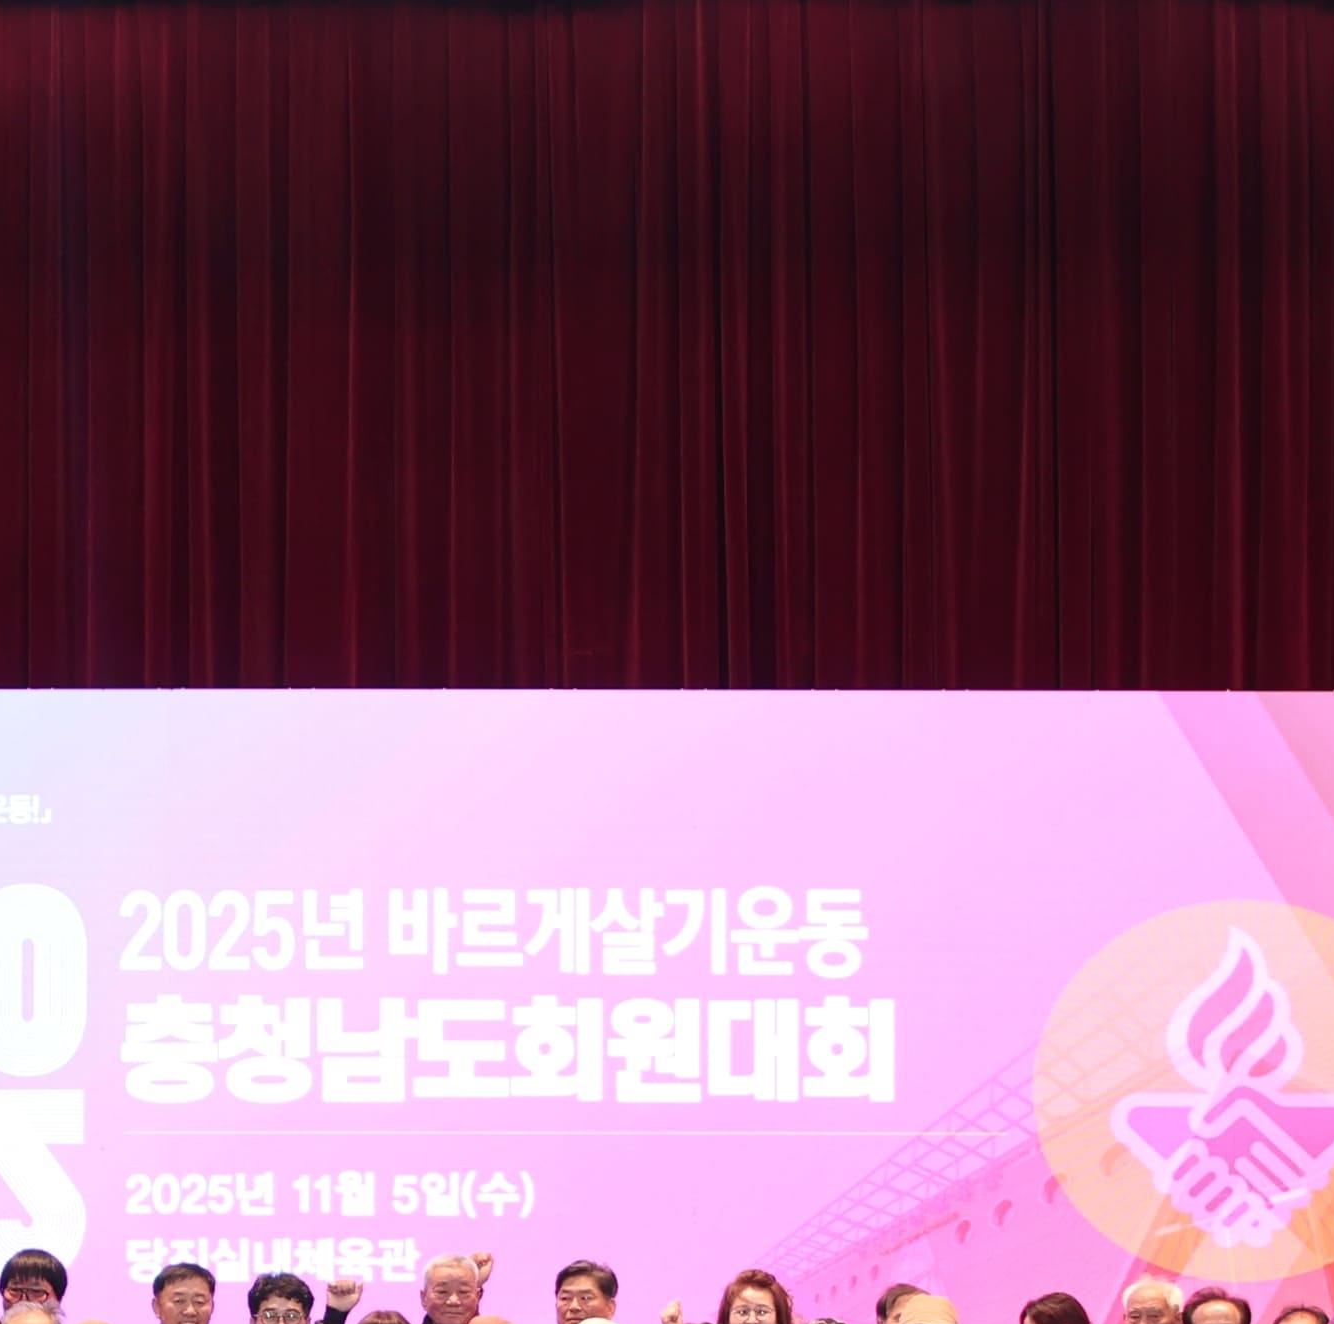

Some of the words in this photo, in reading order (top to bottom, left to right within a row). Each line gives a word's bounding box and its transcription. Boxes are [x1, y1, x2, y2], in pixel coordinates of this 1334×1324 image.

[119, 889, 365, 972] 2025년
[388, 887, 868, 978] 바르게살기운동
[121, 995, 895, 1103] 충청남도회원대회
[125, 1172, 275, 1215] 2025년
[293, 1171, 375, 1216] 11월
[393, 1171, 535, 1218] 5일(수)
